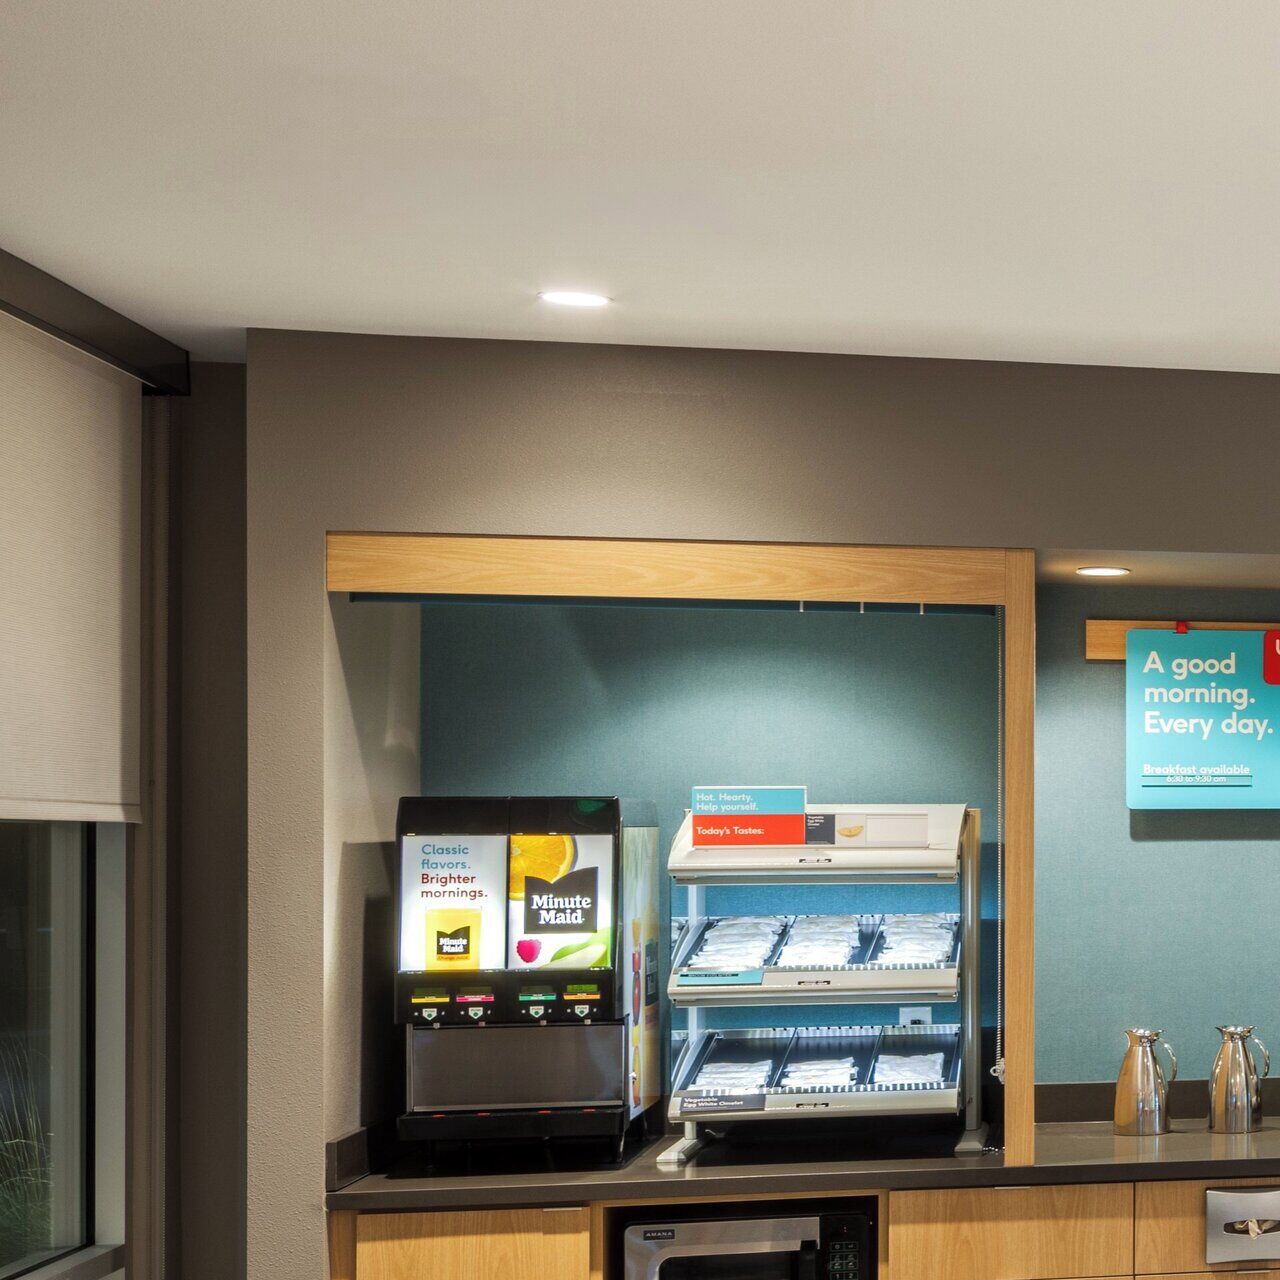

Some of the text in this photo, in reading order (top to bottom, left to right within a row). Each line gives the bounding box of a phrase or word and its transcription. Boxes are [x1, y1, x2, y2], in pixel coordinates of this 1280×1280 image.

[1143, 651, 1236, 681] A good
[1144, 682, 1256, 710] morning.
[1144, 710, 1274, 740] Every day.
[1143, 764, 1250, 775] Breakfast available
[696, 793, 753, 803] Hot. Hearty.
[696, 803, 759, 812] Help yourself.
[696, 826, 765, 837] Today's Tastes:
[421, 844, 469, 855] Classic
[421, 859, 471, 869] flavors.
[421, 873, 476, 887] Brighter
[421, 888, 488, 900] mornings.
[531, 894, 591, 909] Minute
[539, 909, 583, 924] Maid
